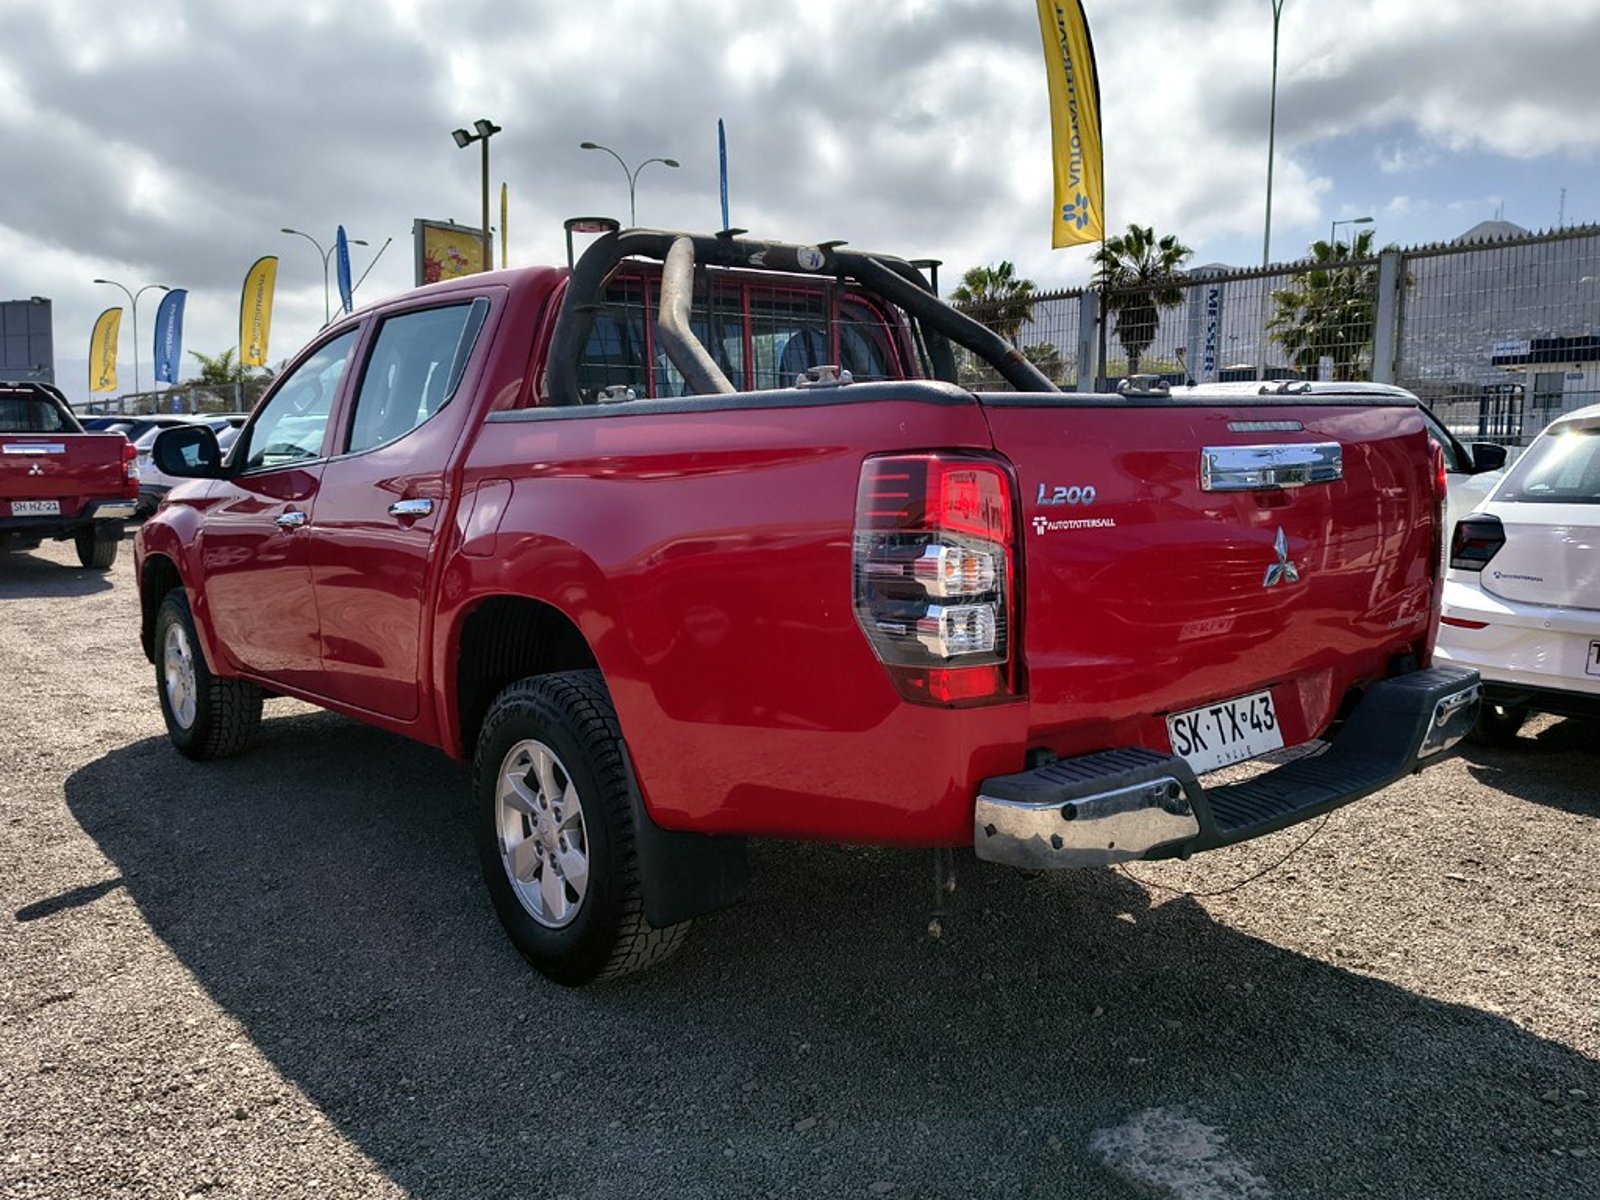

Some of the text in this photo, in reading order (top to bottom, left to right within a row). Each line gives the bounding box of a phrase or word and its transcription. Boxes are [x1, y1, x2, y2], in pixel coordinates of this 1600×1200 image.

[1205, 288, 1219, 372] MESSER
[1037, 483, 1096, 506] L200
[1047, 518, 1116, 531] AUTOTATTERSALL
